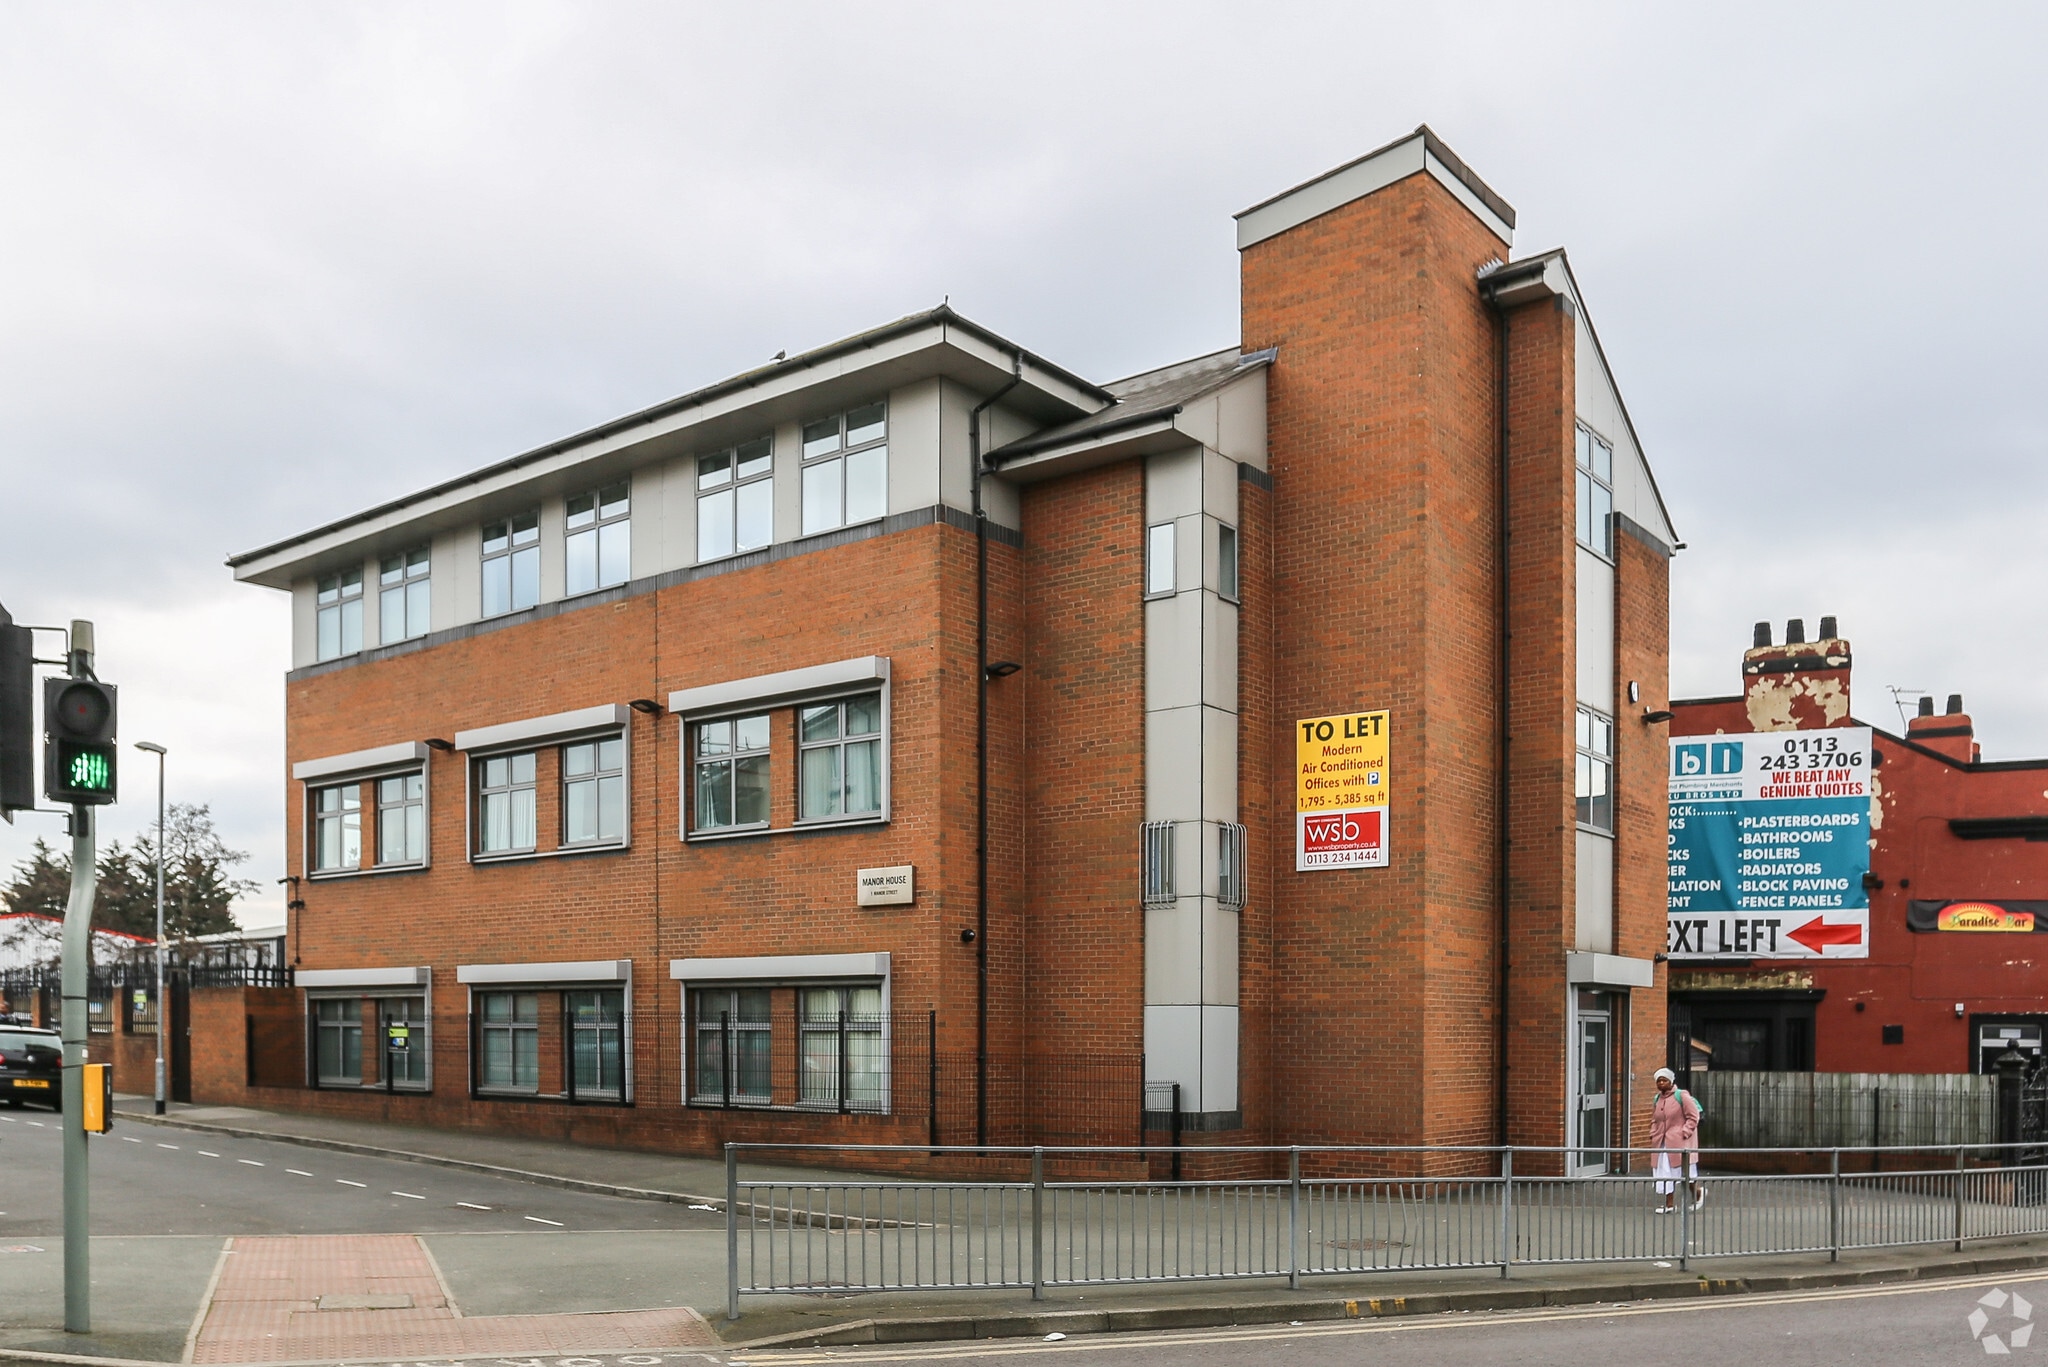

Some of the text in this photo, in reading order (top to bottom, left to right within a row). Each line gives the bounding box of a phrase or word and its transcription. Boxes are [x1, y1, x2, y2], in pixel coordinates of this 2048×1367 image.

[1302, 715, 1383, 743] TO LET
[1322, 744, 1362, 757] Modern
[1784, 737, 1838, 754] 0113
[1302, 756, 1384, 775] Air Conditioned
[1681, 748, 1731, 774] bl
[1760, 751, 1863, 771] 243 3706
[1305, 777, 1340, 790] Offices
[1342, 774, 1365, 787] with
[1772, 768, 1851, 784] WE BEAT ANY
[1679, 782, 1708, 790] Plumbing
[1760, 782, 1863, 799] GENIUNE QUOTES
[1300, 795, 1325, 809] 1,795
[1335, 793, 1361, 807] 5,385
[1364, 793, 1375, 805] sq
[1378, 791, 1385, 802] ft
[1685, 791, 1714, 799] BROS
[1719, 790, 1739, 798] LTD
[1307, 813, 1360, 843] wsb
[1668, 818, 1686, 830] KS
[1743, 813, 1860, 829] PLASTERBOARDS
[1743, 830, 1833, 845] BATHROOMS
[1307, 841, 1378, 852] www.wsbproperty.co.uk
[1743, 847, 1801, 861] BOILERS
[1307, 850, 1378, 865] 0113 234 1444
[1743, 863, 1822, 876] RADIATORS
[862, 876, 906, 886] MANOR HOUSE
[1743, 877, 1850, 892] BLOCK PAVING
[1668, 896, 1691, 908] ENT
[1743, 894, 1843, 908] FENCE PANELS
[1950, 914, 2028, 929] Paradise Bar
[1718, 918, 1782, 952] LEFT
